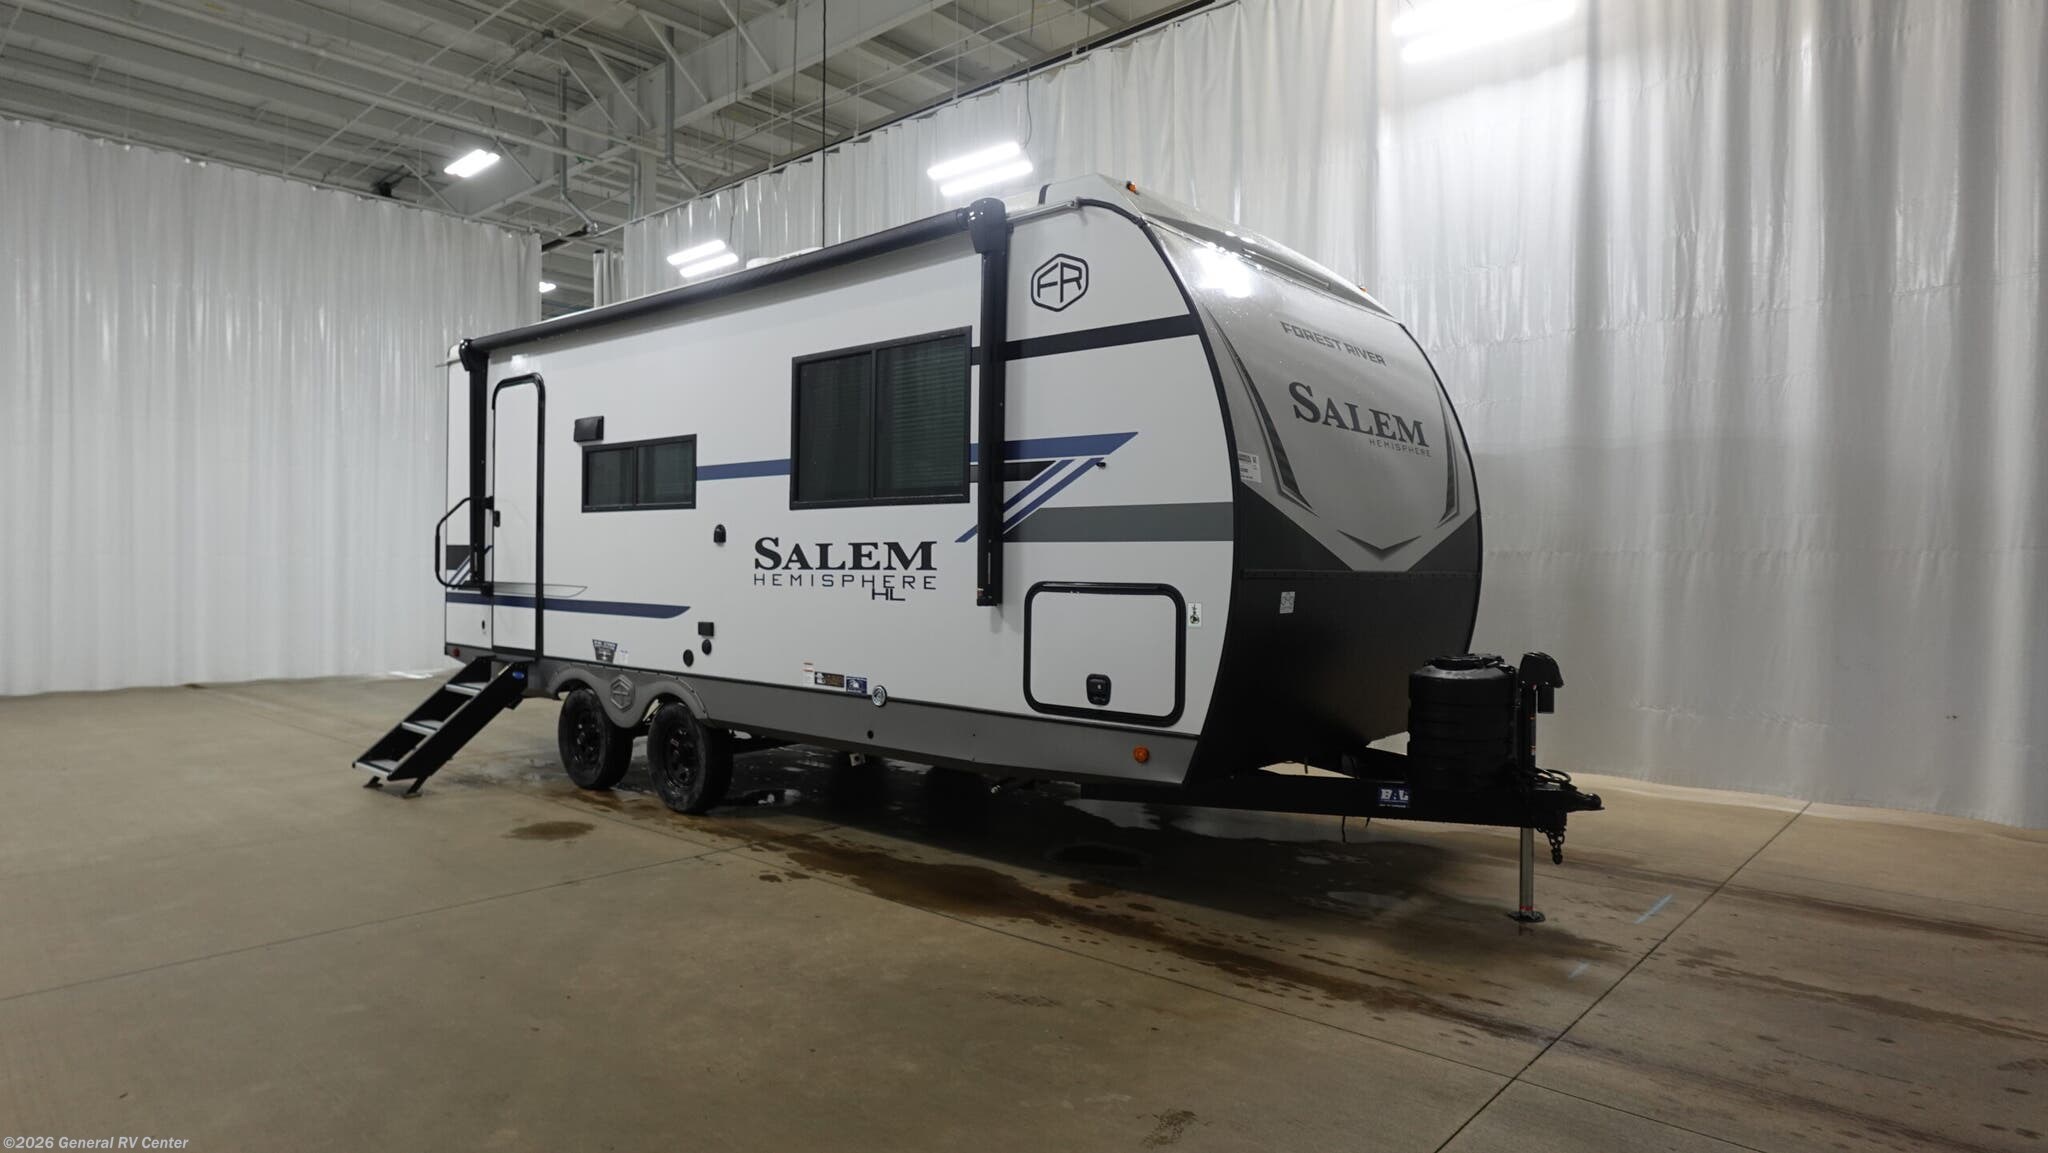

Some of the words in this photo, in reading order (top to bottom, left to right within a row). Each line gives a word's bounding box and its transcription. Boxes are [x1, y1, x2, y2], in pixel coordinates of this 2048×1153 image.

[1037, 261, 1083, 303] FR
[1279, 320, 1342, 351] FOREST
[1343, 342, 1387, 367] RIVER
[1288, 381, 1430, 448] SALEM
[1369, 439, 1432, 458] HEMISPHERE
[754, 536, 938, 571] SALEM
[753, 573, 937, 590] HEMISPHERE
[871, 587, 906, 601] HL
